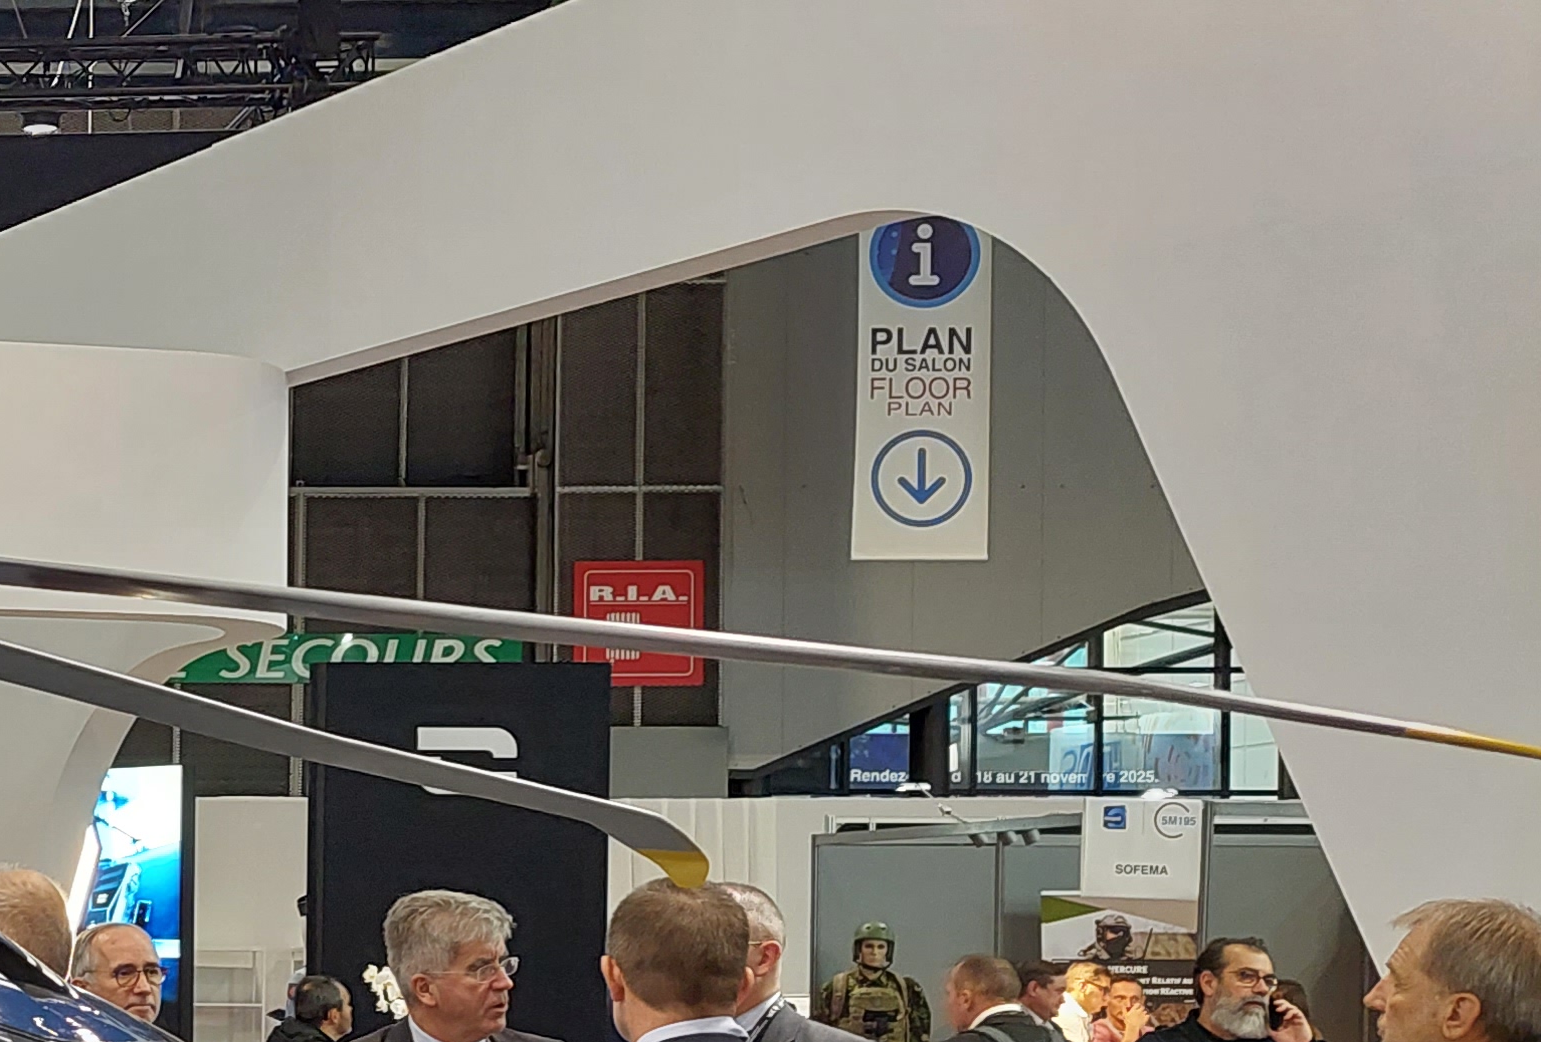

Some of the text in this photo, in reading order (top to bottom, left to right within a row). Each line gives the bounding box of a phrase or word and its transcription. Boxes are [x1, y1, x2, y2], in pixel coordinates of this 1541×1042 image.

[871, 327, 972, 355] PLAN
[871, 356, 971, 373] DU SALON
[870, 376, 971, 400] FLOOR
[887, 401, 953, 416] PLAN
[589, 585, 689, 601] R.I.A.
[1114, 863, 1169, 876] SOFEMA
